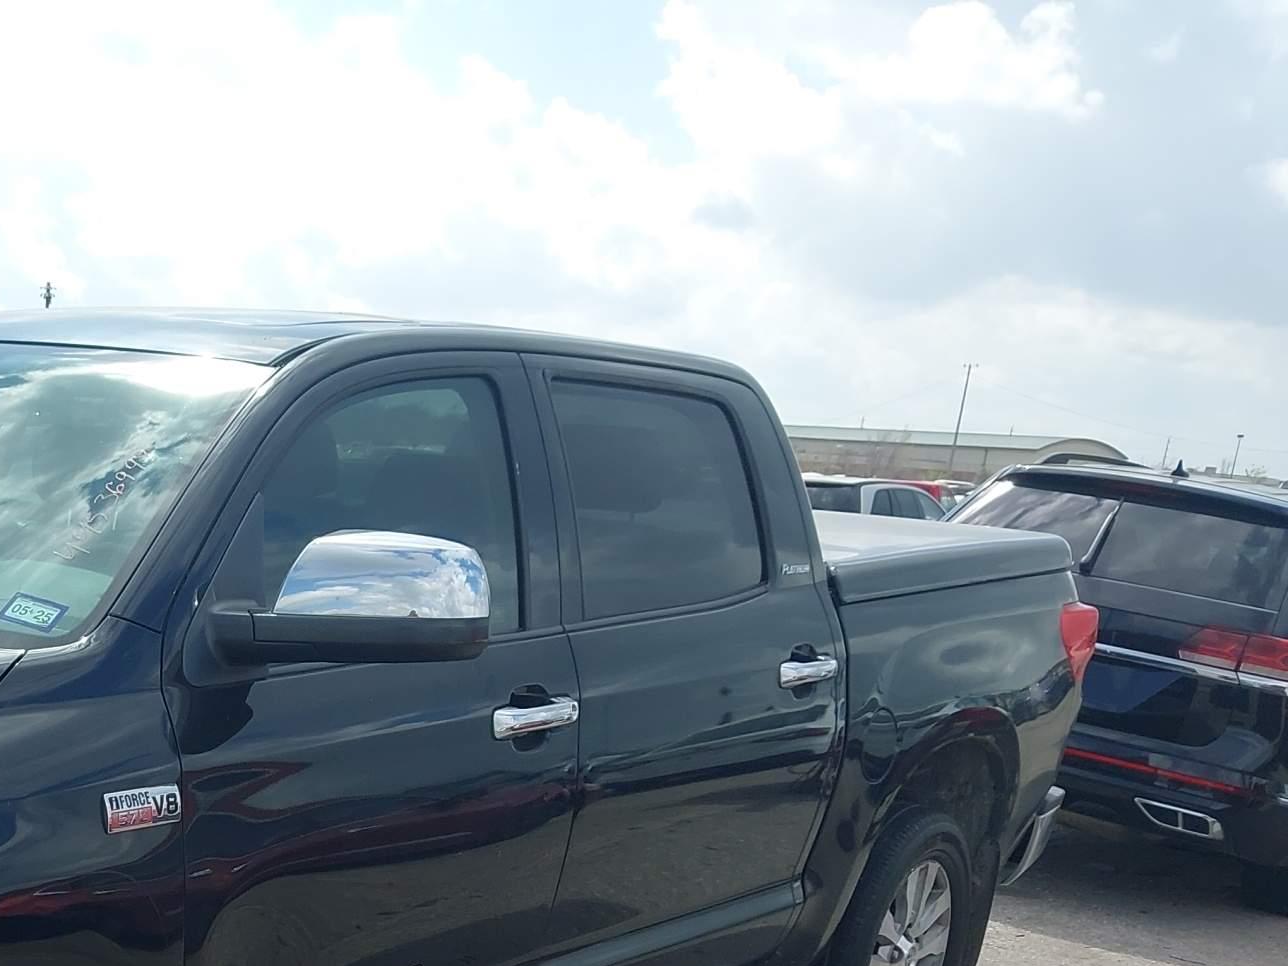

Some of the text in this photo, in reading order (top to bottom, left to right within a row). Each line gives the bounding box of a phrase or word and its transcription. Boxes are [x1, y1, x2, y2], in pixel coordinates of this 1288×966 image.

[11, 603, 54, 623] 05 25
[152, 792, 179, 818] V8
